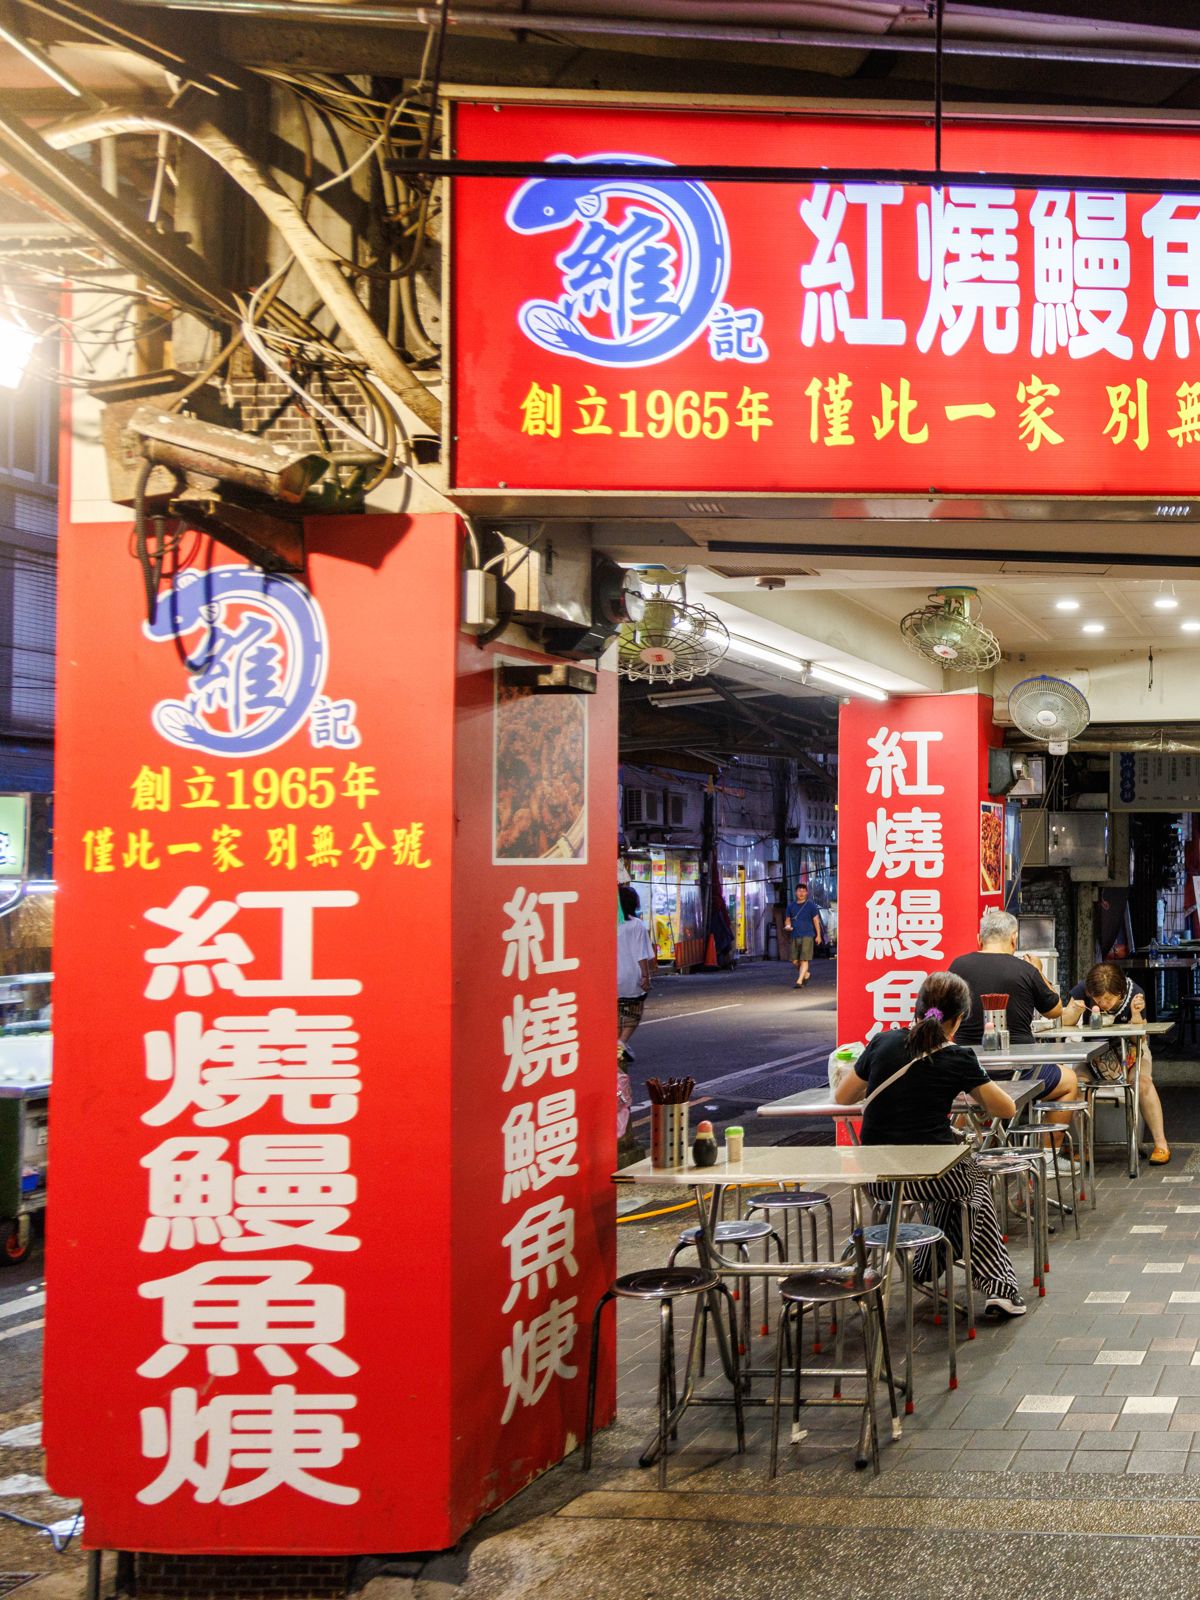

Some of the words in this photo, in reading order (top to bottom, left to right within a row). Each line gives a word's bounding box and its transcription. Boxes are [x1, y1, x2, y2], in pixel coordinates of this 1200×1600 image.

[520, 380, 774, 443] 創立1965年
[804, 372, 1065, 452] 僅此一家
[130, 761, 381, 812] 創立1965年
[82, 824, 244, 873] 僅此一家
[265, 822, 431, 871] 別無分號
[501, 886, 580, 1425] 紅燒鰻魚焿
[136, 885, 363, 1507] 紅燒鰻魚焿
